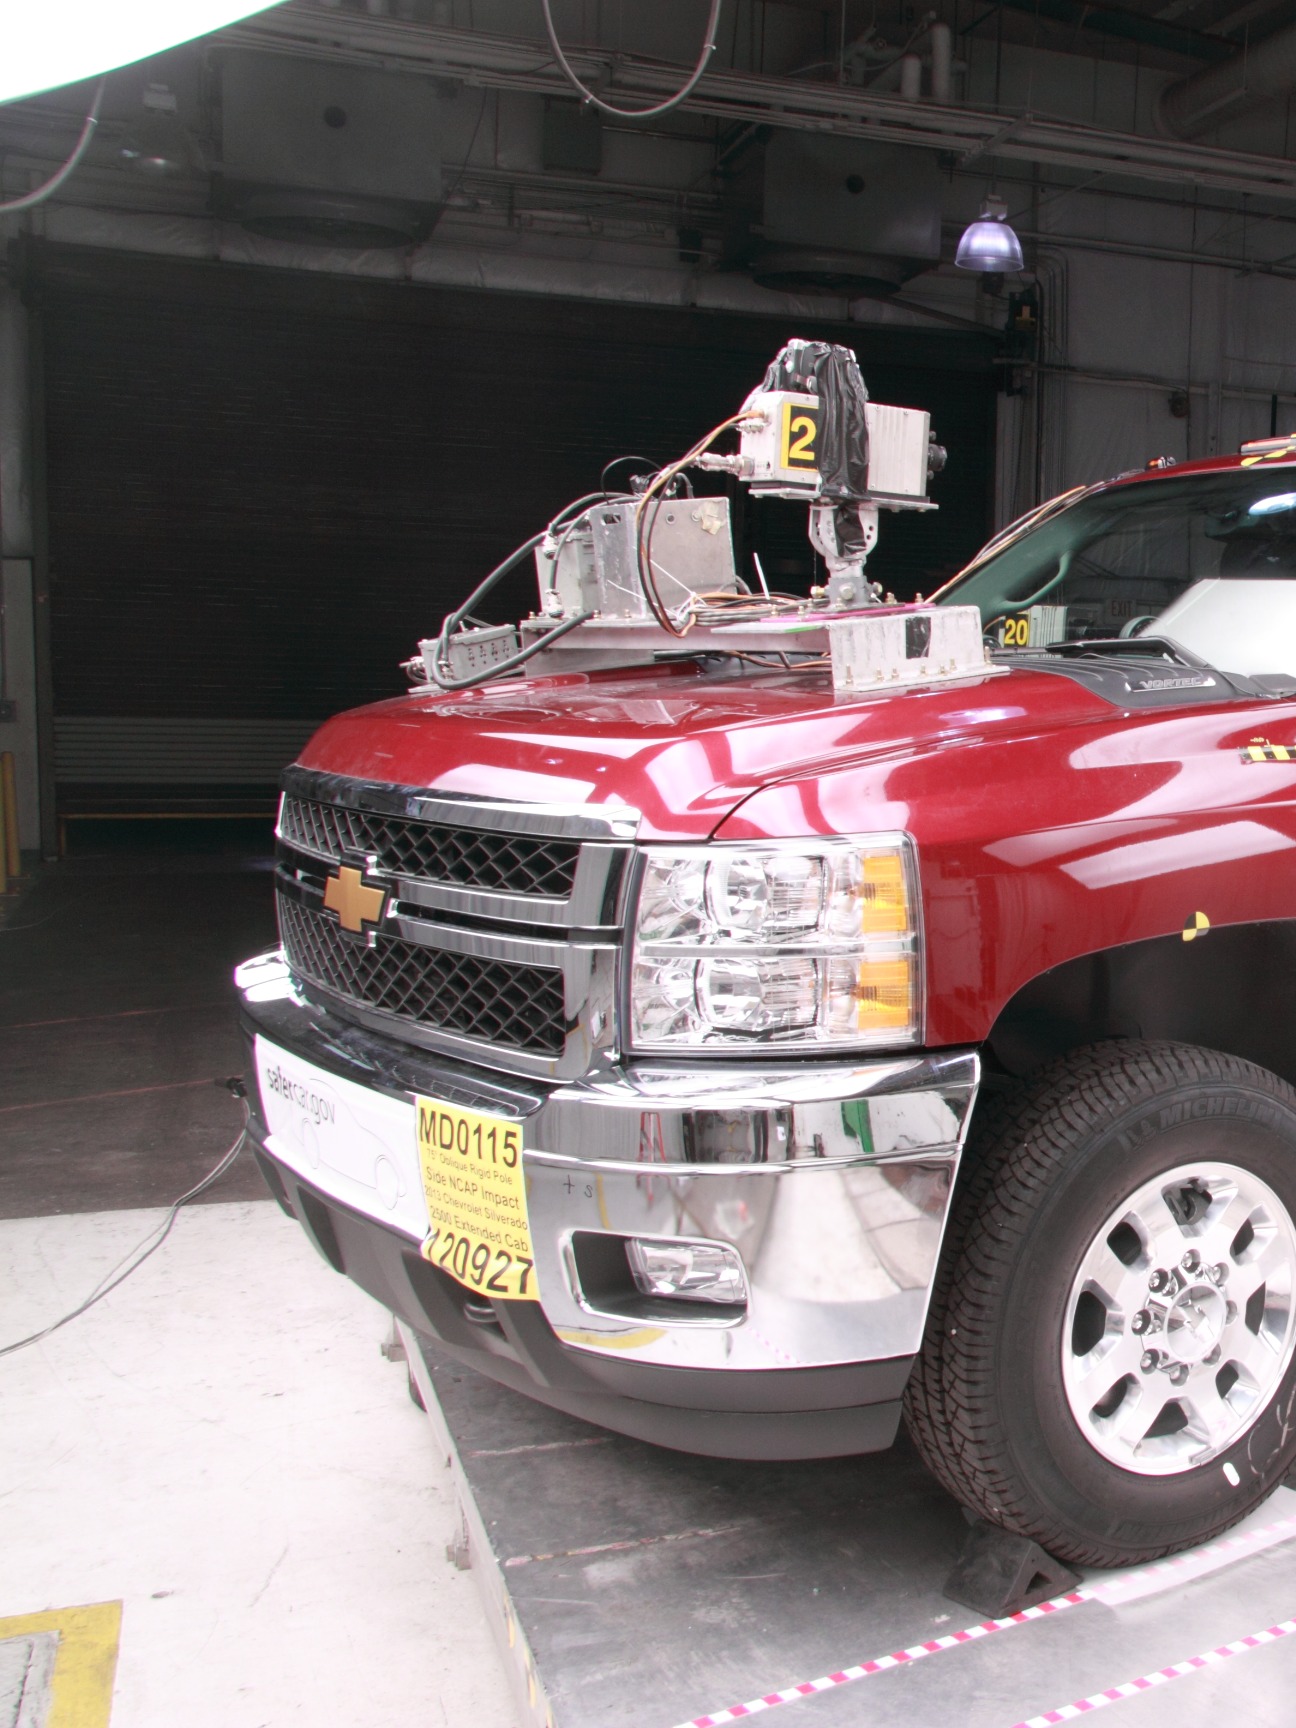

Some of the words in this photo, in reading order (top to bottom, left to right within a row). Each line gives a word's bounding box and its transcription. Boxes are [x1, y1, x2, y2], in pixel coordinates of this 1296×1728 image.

[789, 416, 817, 461] 2
[1111, 600, 1133, 617] EXIT
[1005, 619, 1028, 646] 20
[1139, 676, 1202, 689] VORTEC
[266, 1065, 336, 1125] safercar.gov
[1160, 1097, 1278, 1130] MICHELIN
[419, 1107, 518, 1168] MD0115
[426, 1166, 447, 1186] Side
[449, 1175, 478, 1196] NCAP
[481, 1185, 520, 1210] Impact
[439, 1152, 468, 1173] Oblique
[469, 1160, 492, 1180] Rigid
[493, 1169, 513, 1185] Pole
[425, 1185, 441, 1201] 2013
[443, 1192, 482, 1217] Chevrolet
[484, 1207, 528, 1231] Silverado
[430, 1205, 452, 1225] 2500
[454, 1214, 502, 1244] Extended
[505, 1233, 529, 1252] Cab
[426, 1227, 534, 1295] 120927
